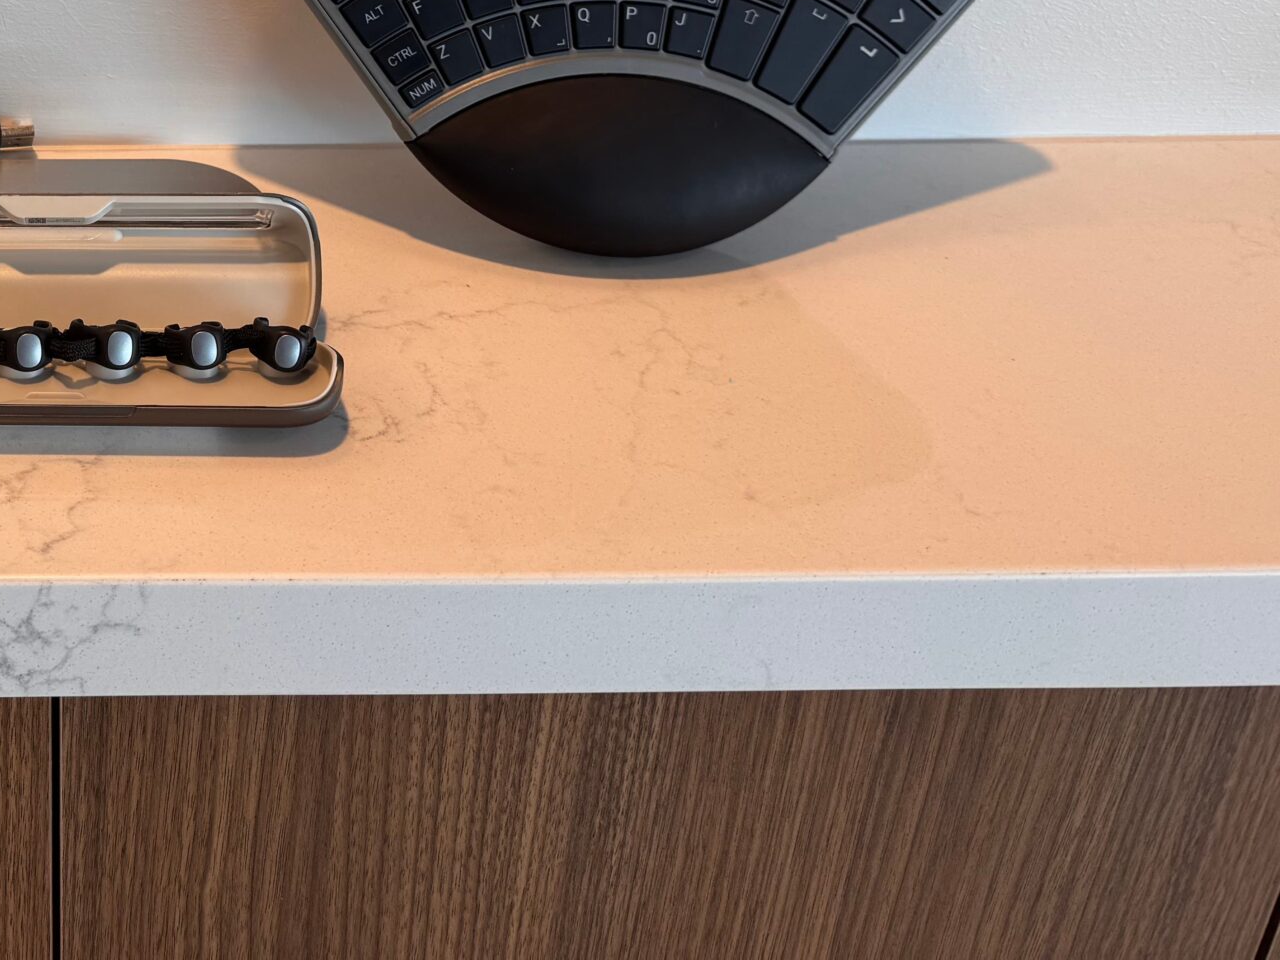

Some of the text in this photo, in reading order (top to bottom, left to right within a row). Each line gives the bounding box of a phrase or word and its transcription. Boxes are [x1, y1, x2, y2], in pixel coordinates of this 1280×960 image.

[365, 5, 383, 23] ALT
[413, 0, 421, 14] F
[627, 7, 637, 19] P
[530, 15, 541, 28] X
[578, 8, 589, 22] Q
[675, 13, 686, 25] J
[482, 27, 492, 40] V
[647, 32, 656, 45] 0
[388, 47, 416, 66] CTRL
[437, 45, 449, 59] Z
[409, 79, 436, 99] NUM
